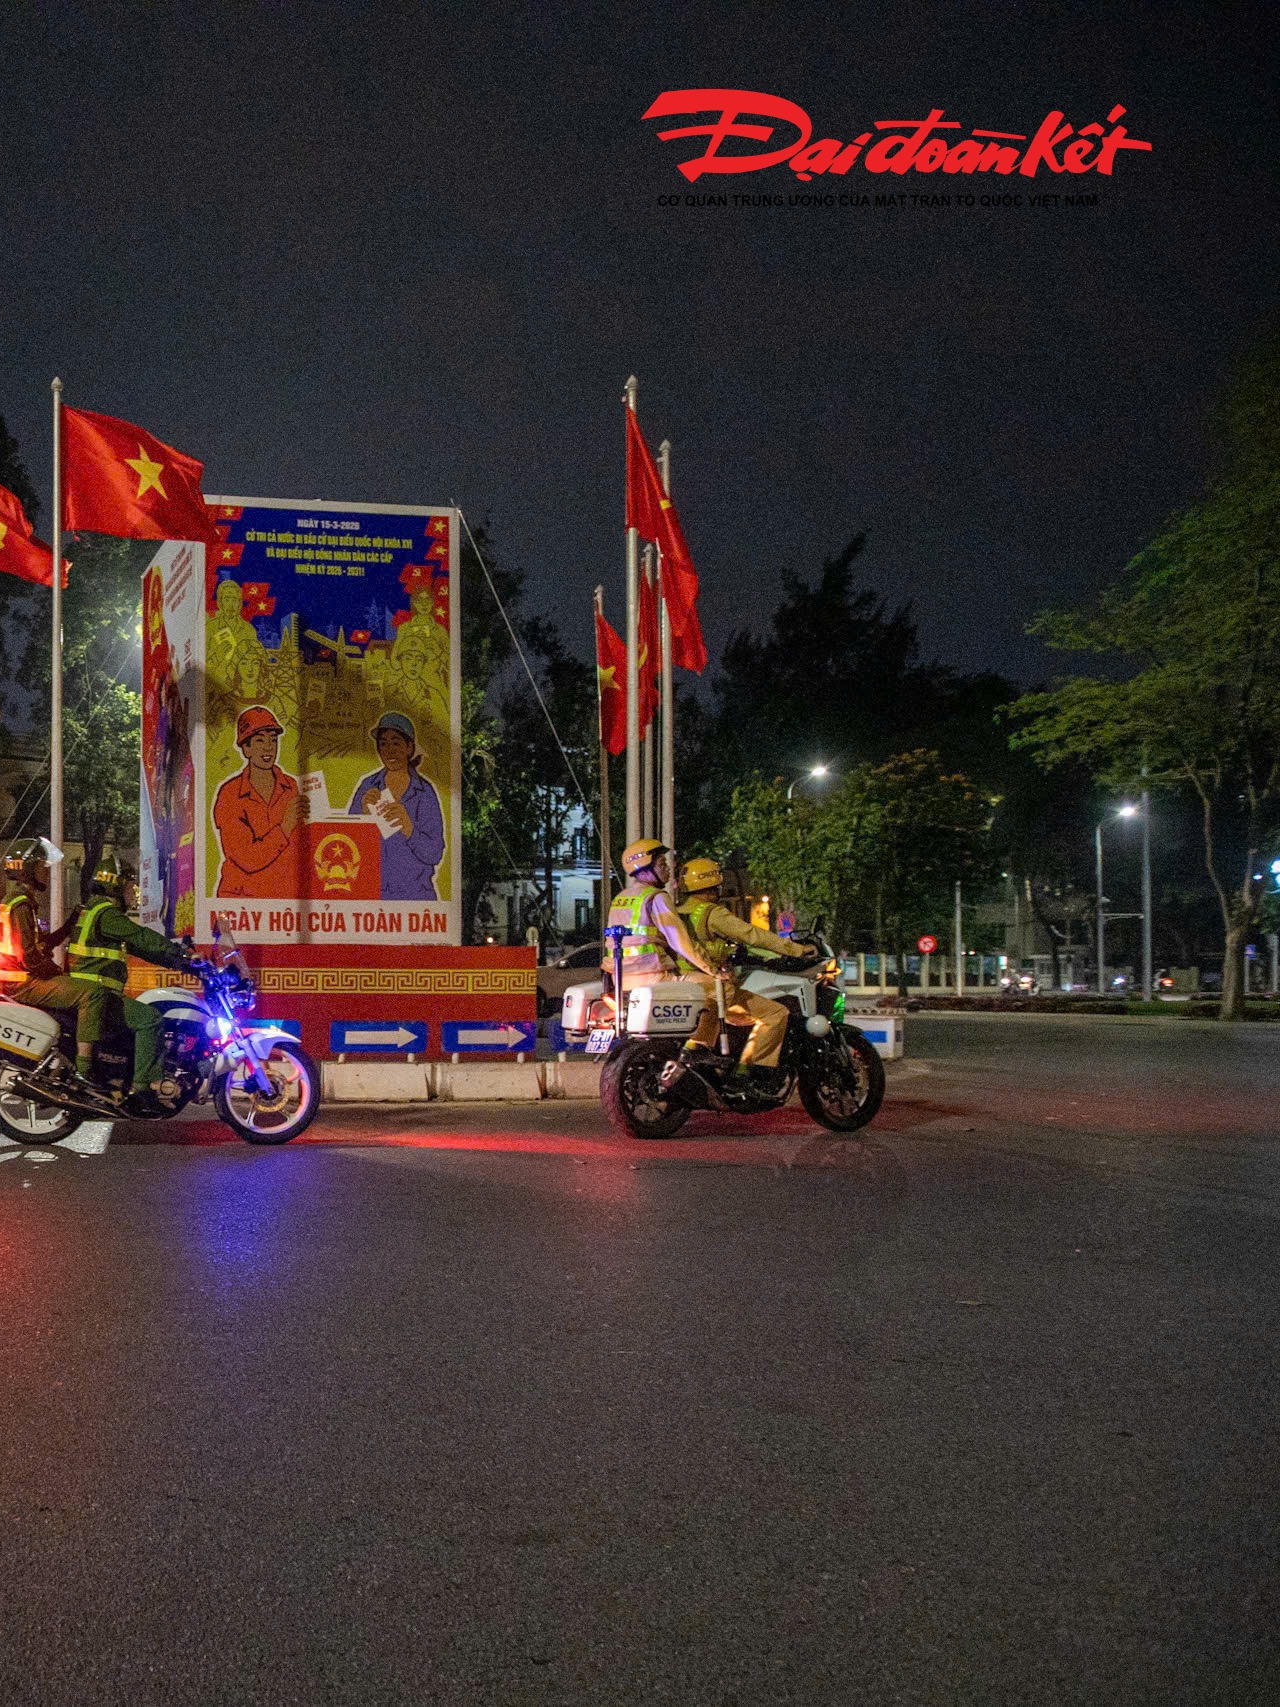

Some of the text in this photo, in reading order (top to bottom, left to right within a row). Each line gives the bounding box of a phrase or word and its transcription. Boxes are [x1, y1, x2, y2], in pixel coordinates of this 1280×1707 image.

[297, 518, 319, 528] NGÀY
[269, 906, 302, 937] HỘI
[307, 903, 347, 933] CỦA
[352, 907, 402, 933] TOÀN
[408, 908, 448, 933] DÂN
